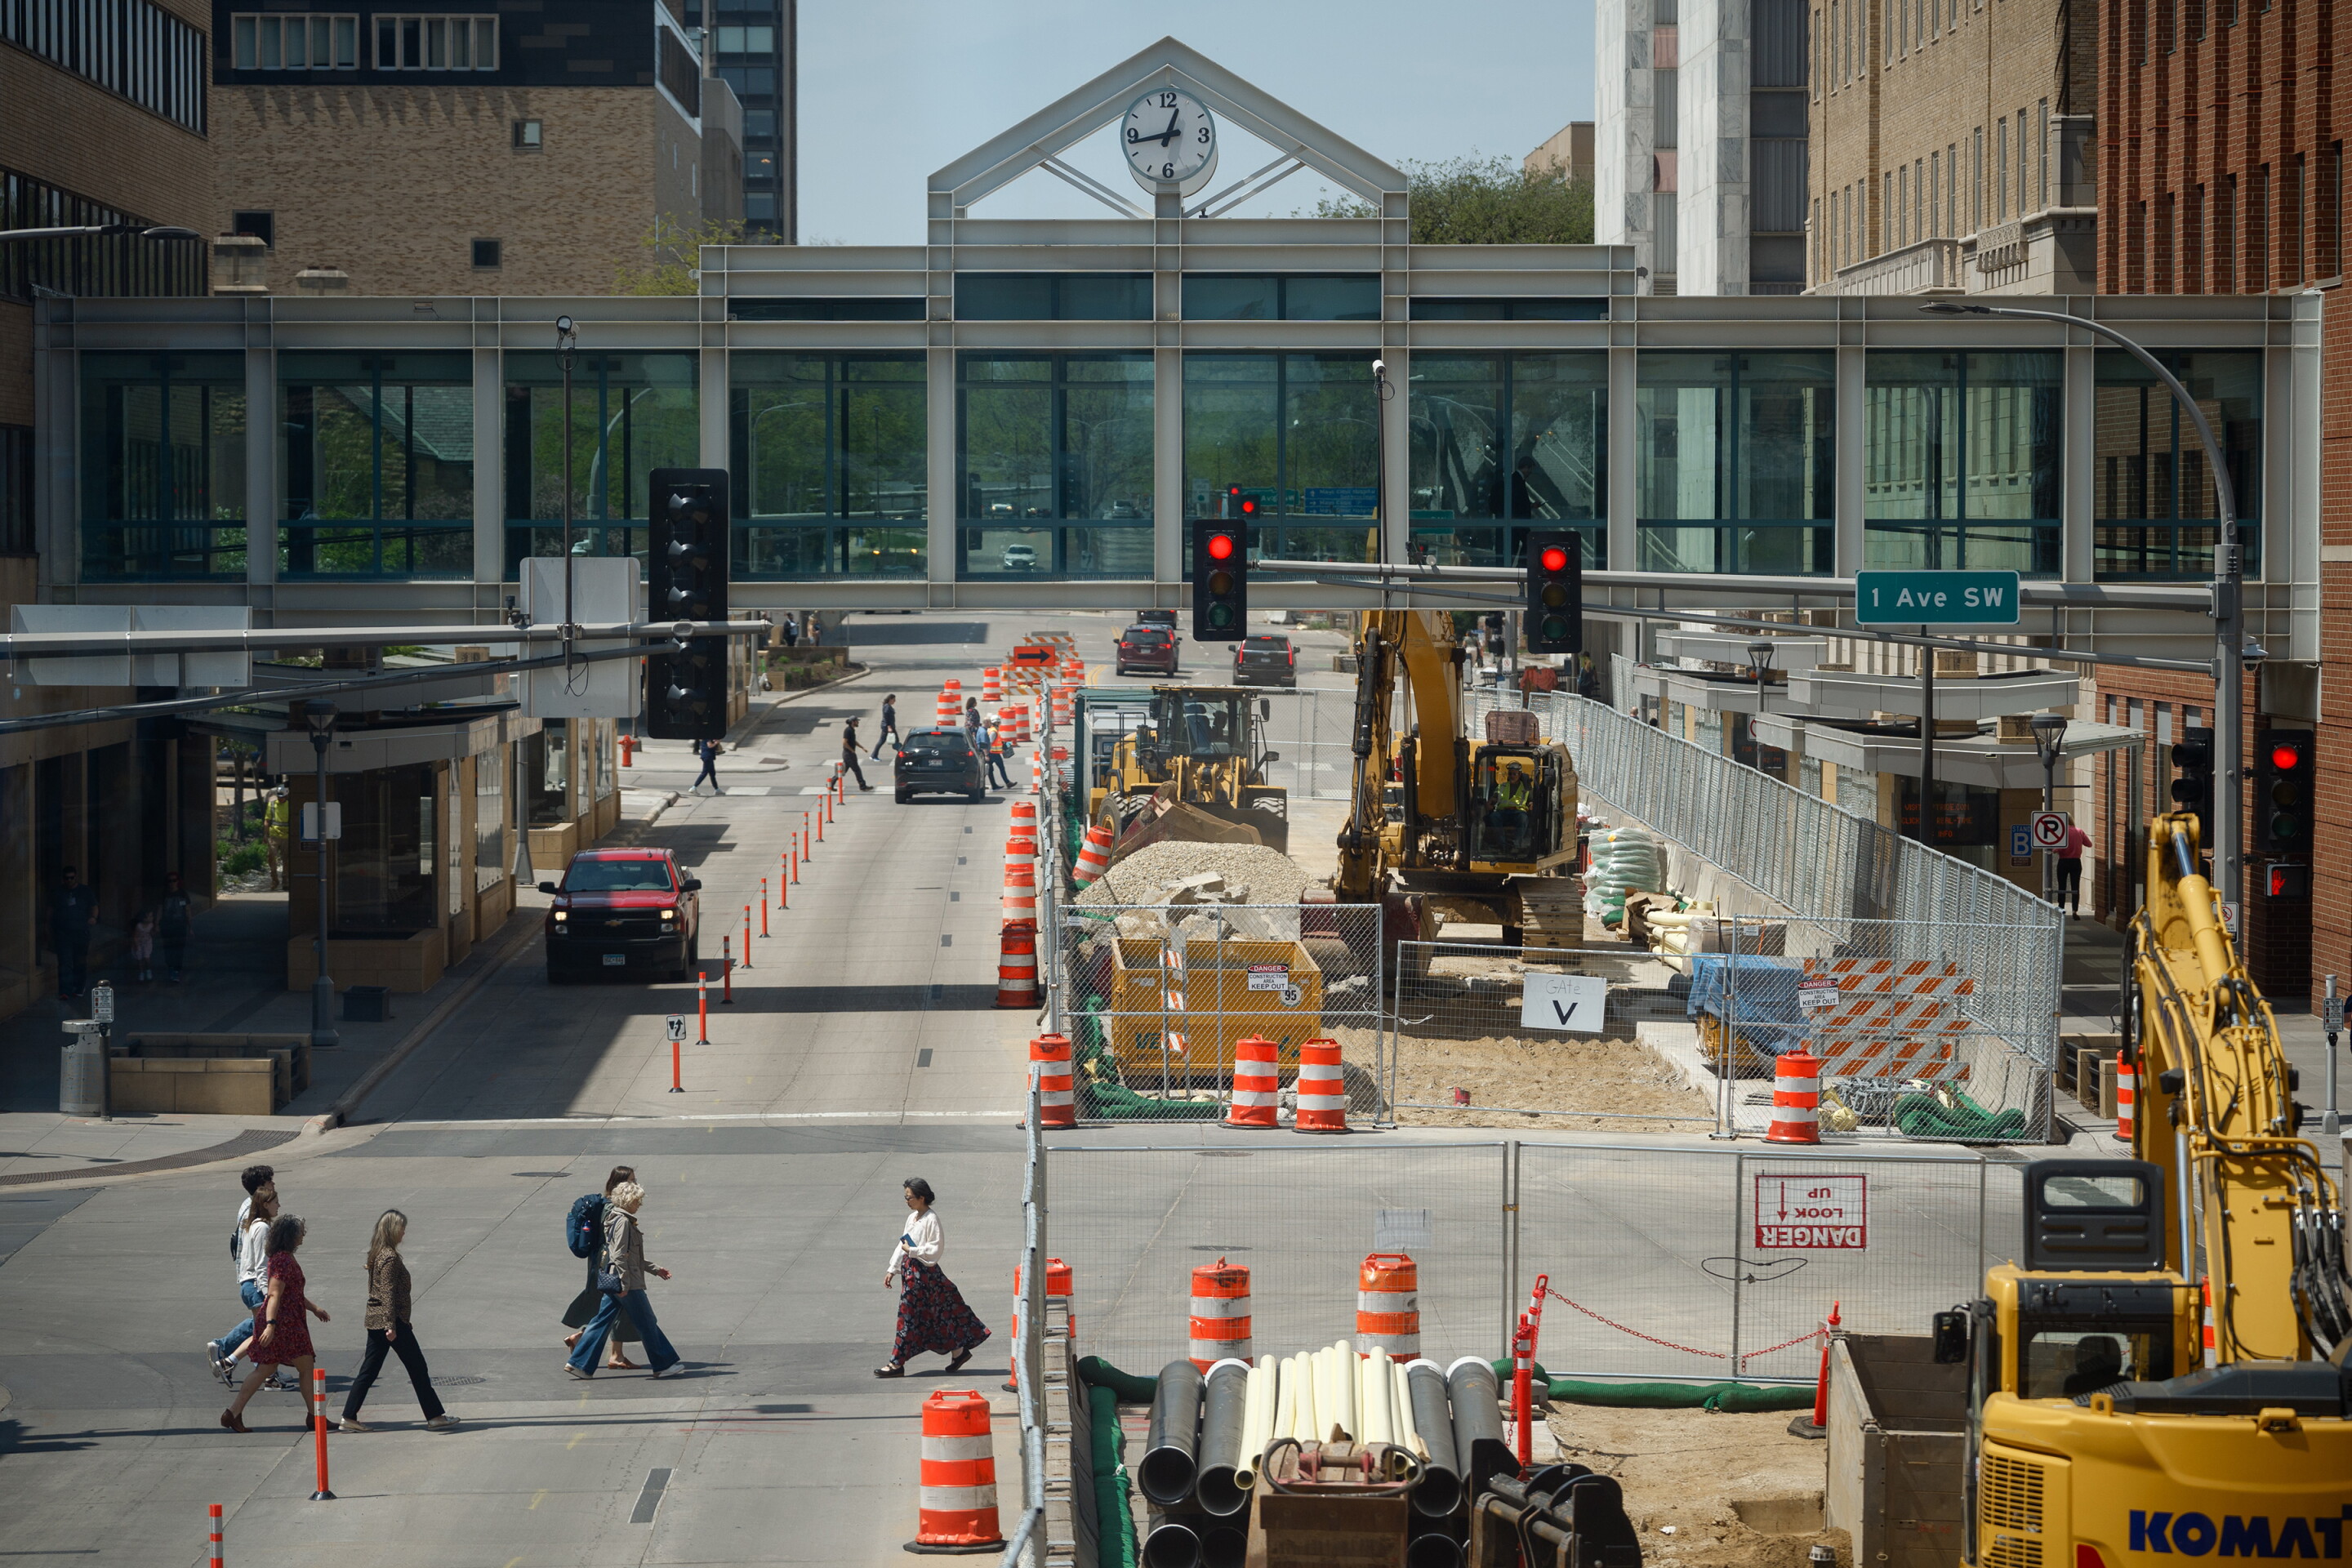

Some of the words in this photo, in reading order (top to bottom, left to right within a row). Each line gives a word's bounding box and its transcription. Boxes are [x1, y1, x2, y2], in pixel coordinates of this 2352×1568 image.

[1159, 92, 1178, 108] 12
[1126, 127, 1139, 145] 9
[1197, 127, 1210, 143] 3
[1162, 163, 1174, 178] 6
[1872, 587, 1879, 608] 1
[1895, 587, 1948, 608] Ave
[1963, 587, 2003, 608] SW
[2014, 832, 2029, 854] B
[1285, 990, 1297, 1000] 95
[1552, 1000, 1578, 1026] V
[1136, 1032, 1162, 1049] VE
[1807, 1187, 1831, 1199] UP
[1794, 1208, 1843, 1218] LOOK
[1761, 1227, 1861, 1246] DANGER
[2129, 1504, 2352, 1559] KOMAT
